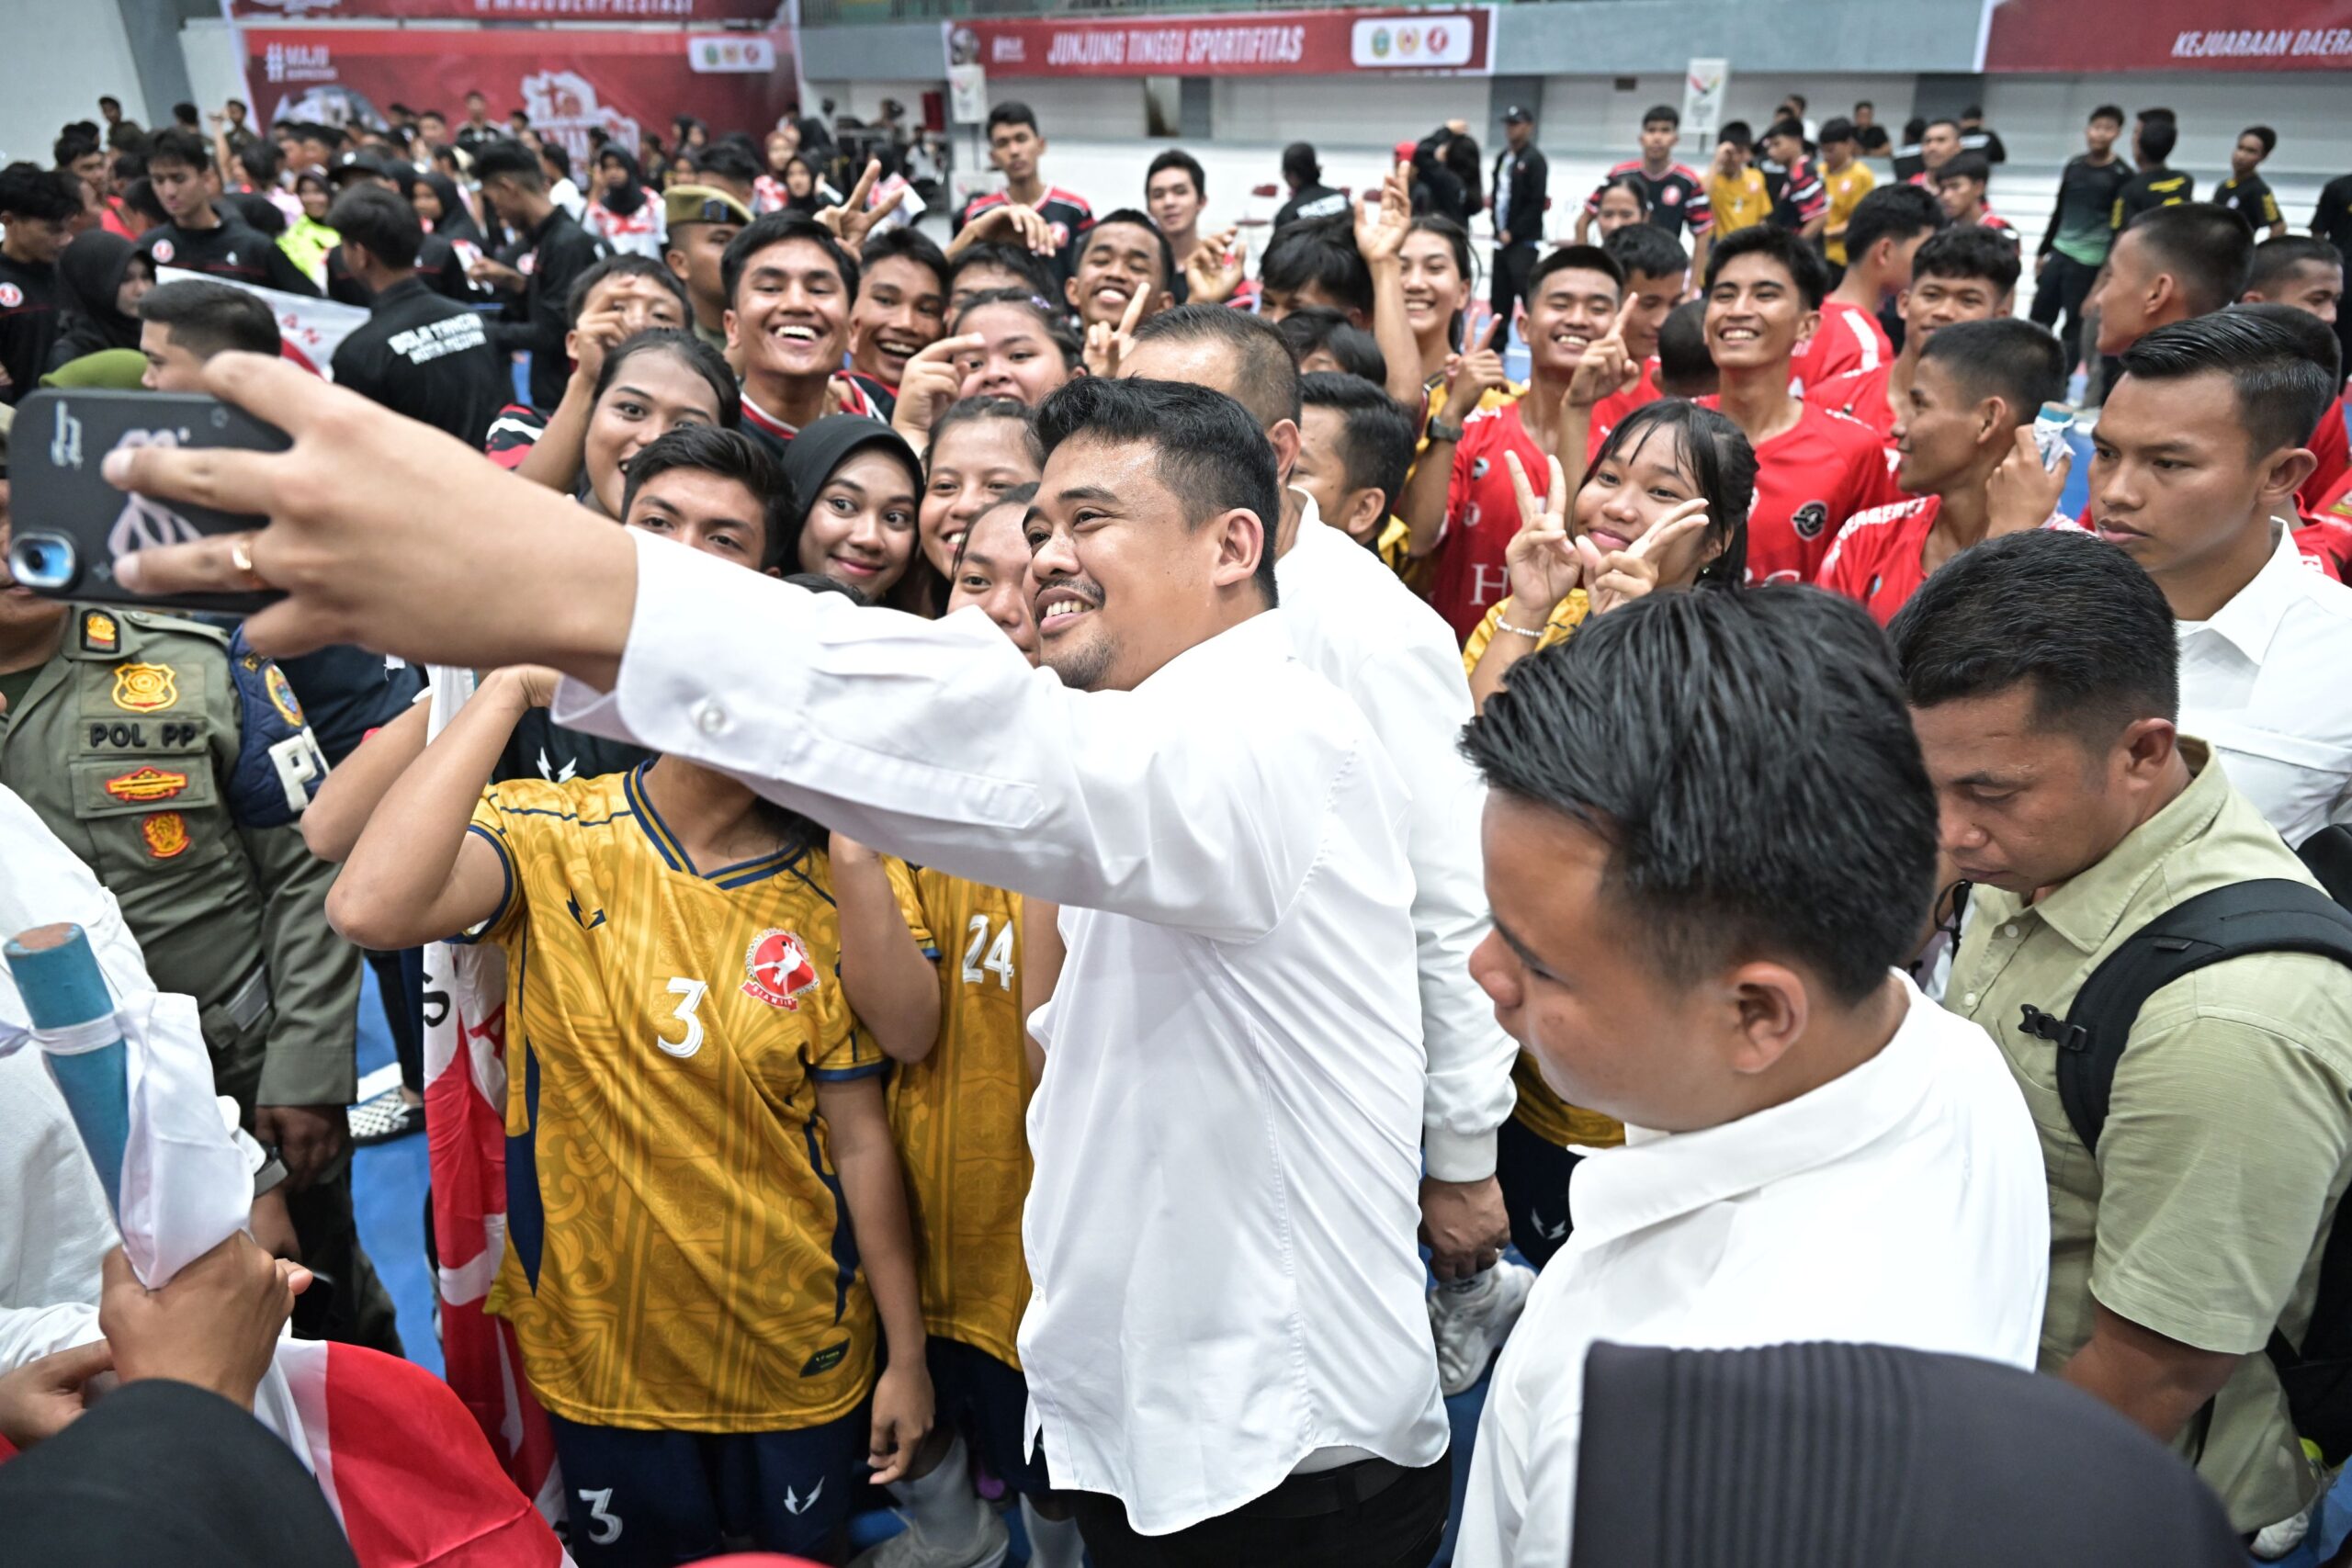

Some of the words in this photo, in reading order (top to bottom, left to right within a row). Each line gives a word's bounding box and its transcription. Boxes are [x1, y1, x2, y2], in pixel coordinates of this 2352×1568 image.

[1046, 31, 1125, 65] JUNJUNG
[1126, 29, 1186, 64] TINGGI
[2171, 29, 2294, 57] KEJUARAAN
[89, 723, 147, 749] POL
[162, 723, 198, 749] PP
[268, 727, 328, 813] P
[962, 914, 1014, 993] 24
[657, 976, 708, 1058] 3
[578, 1488, 623, 1545] 3
